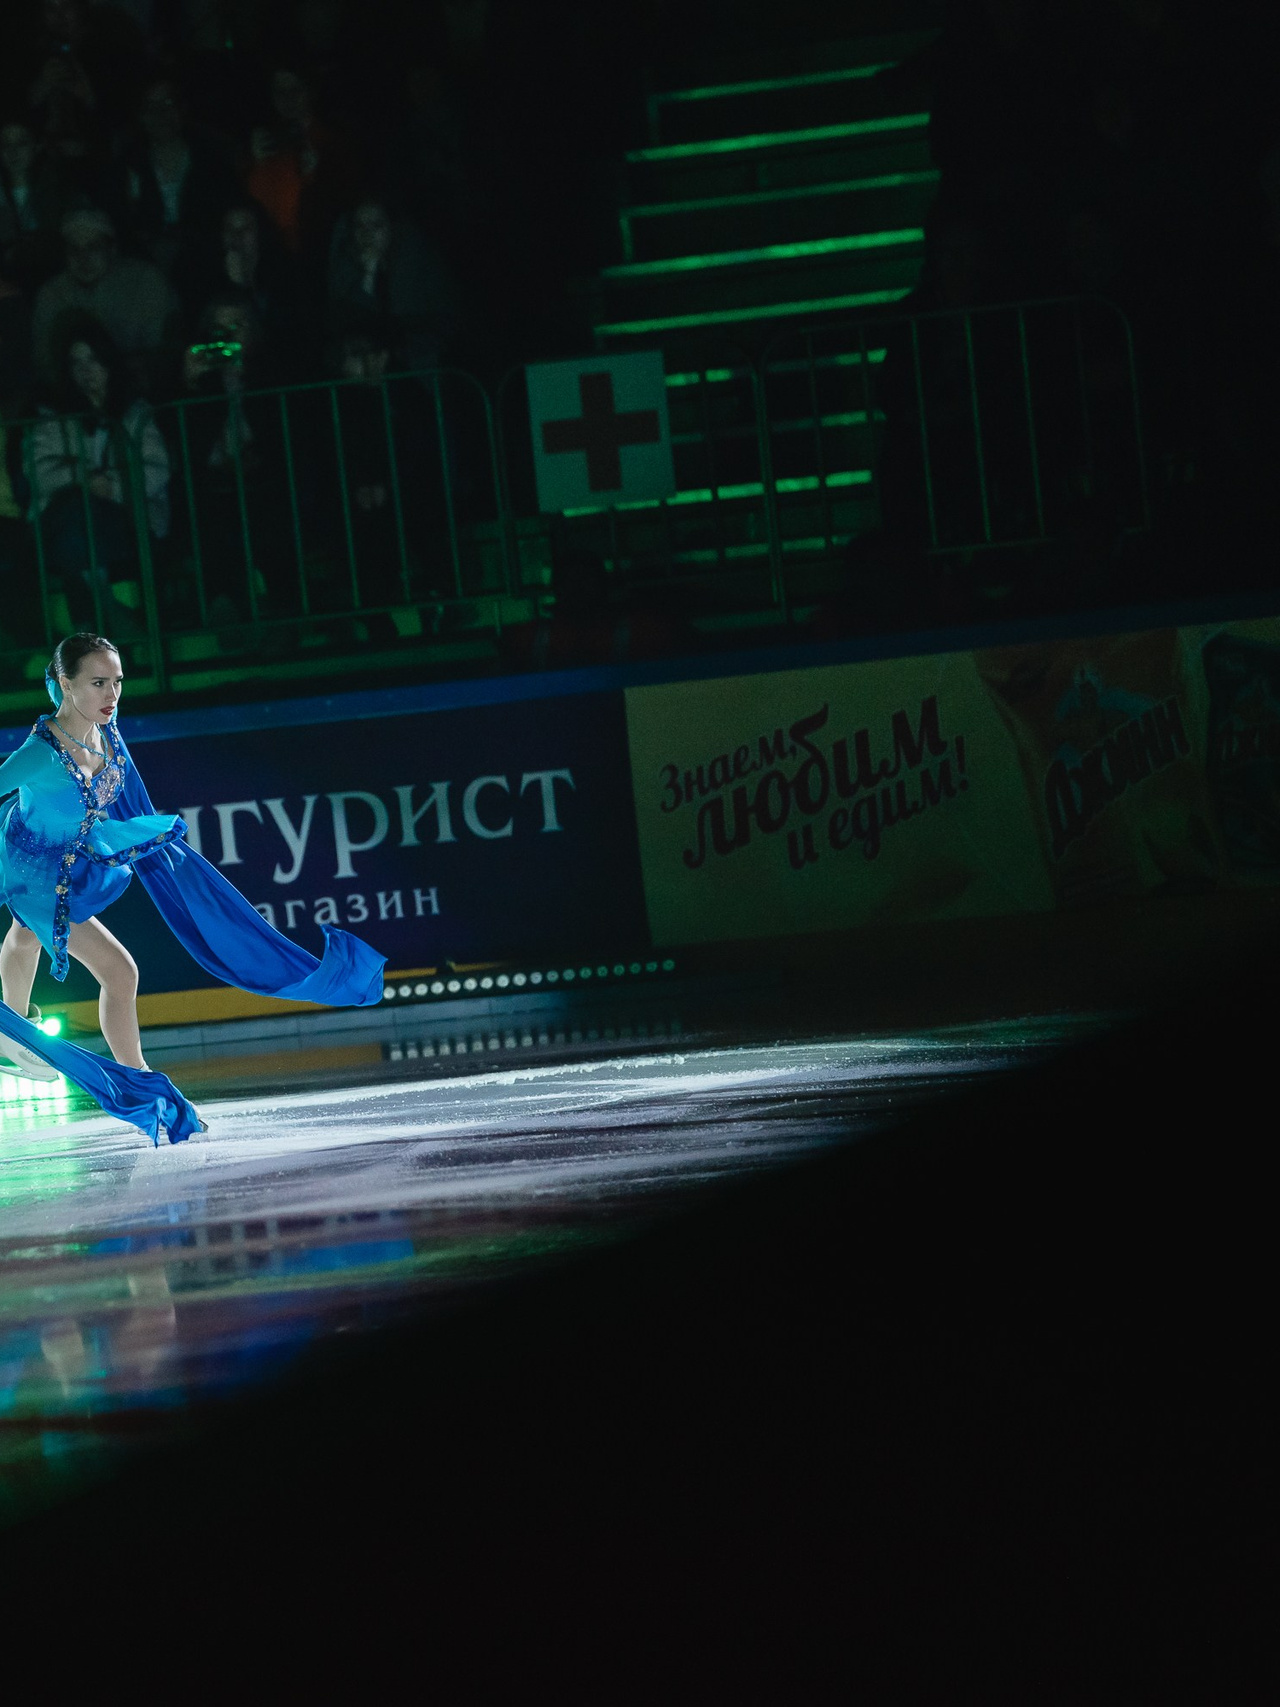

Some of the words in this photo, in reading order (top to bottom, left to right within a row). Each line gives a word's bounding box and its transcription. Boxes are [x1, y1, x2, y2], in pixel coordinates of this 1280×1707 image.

[659, 728, 797, 813] Знаем,
[828, 735, 969, 862] едим!
[252, 886, 441, 930] агазин
